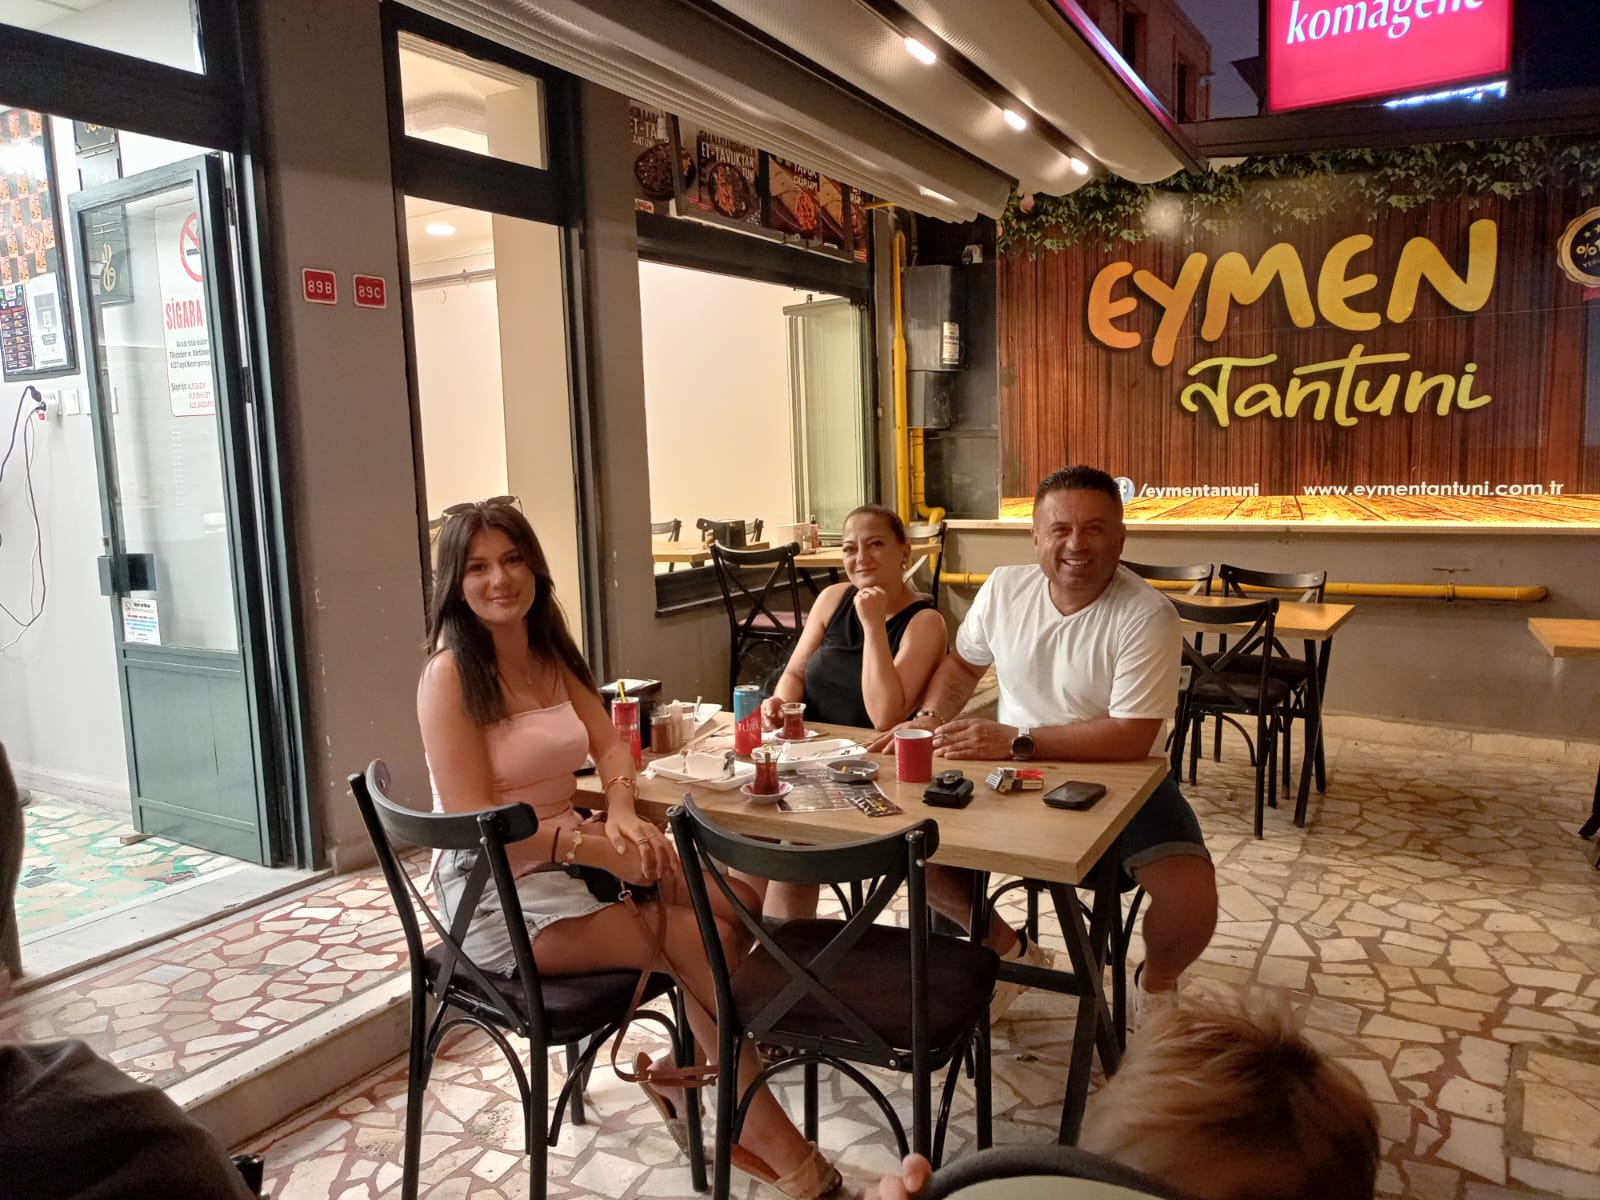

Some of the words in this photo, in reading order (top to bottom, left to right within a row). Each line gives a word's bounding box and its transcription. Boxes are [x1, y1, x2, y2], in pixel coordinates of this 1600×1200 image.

[307, 280, 332, 294] 89B
[358, 285, 381, 299] 89C
[1088, 219, 1498, 366] EYMEN
[165, 297, 203, 331] SİGARA
[1180, 343, 1492, 428] Tantuni
[1139, 483, 1259, 498] /eymentanuni
[1303, 481, 1564, 498] www.eymentantuni.com.tr
